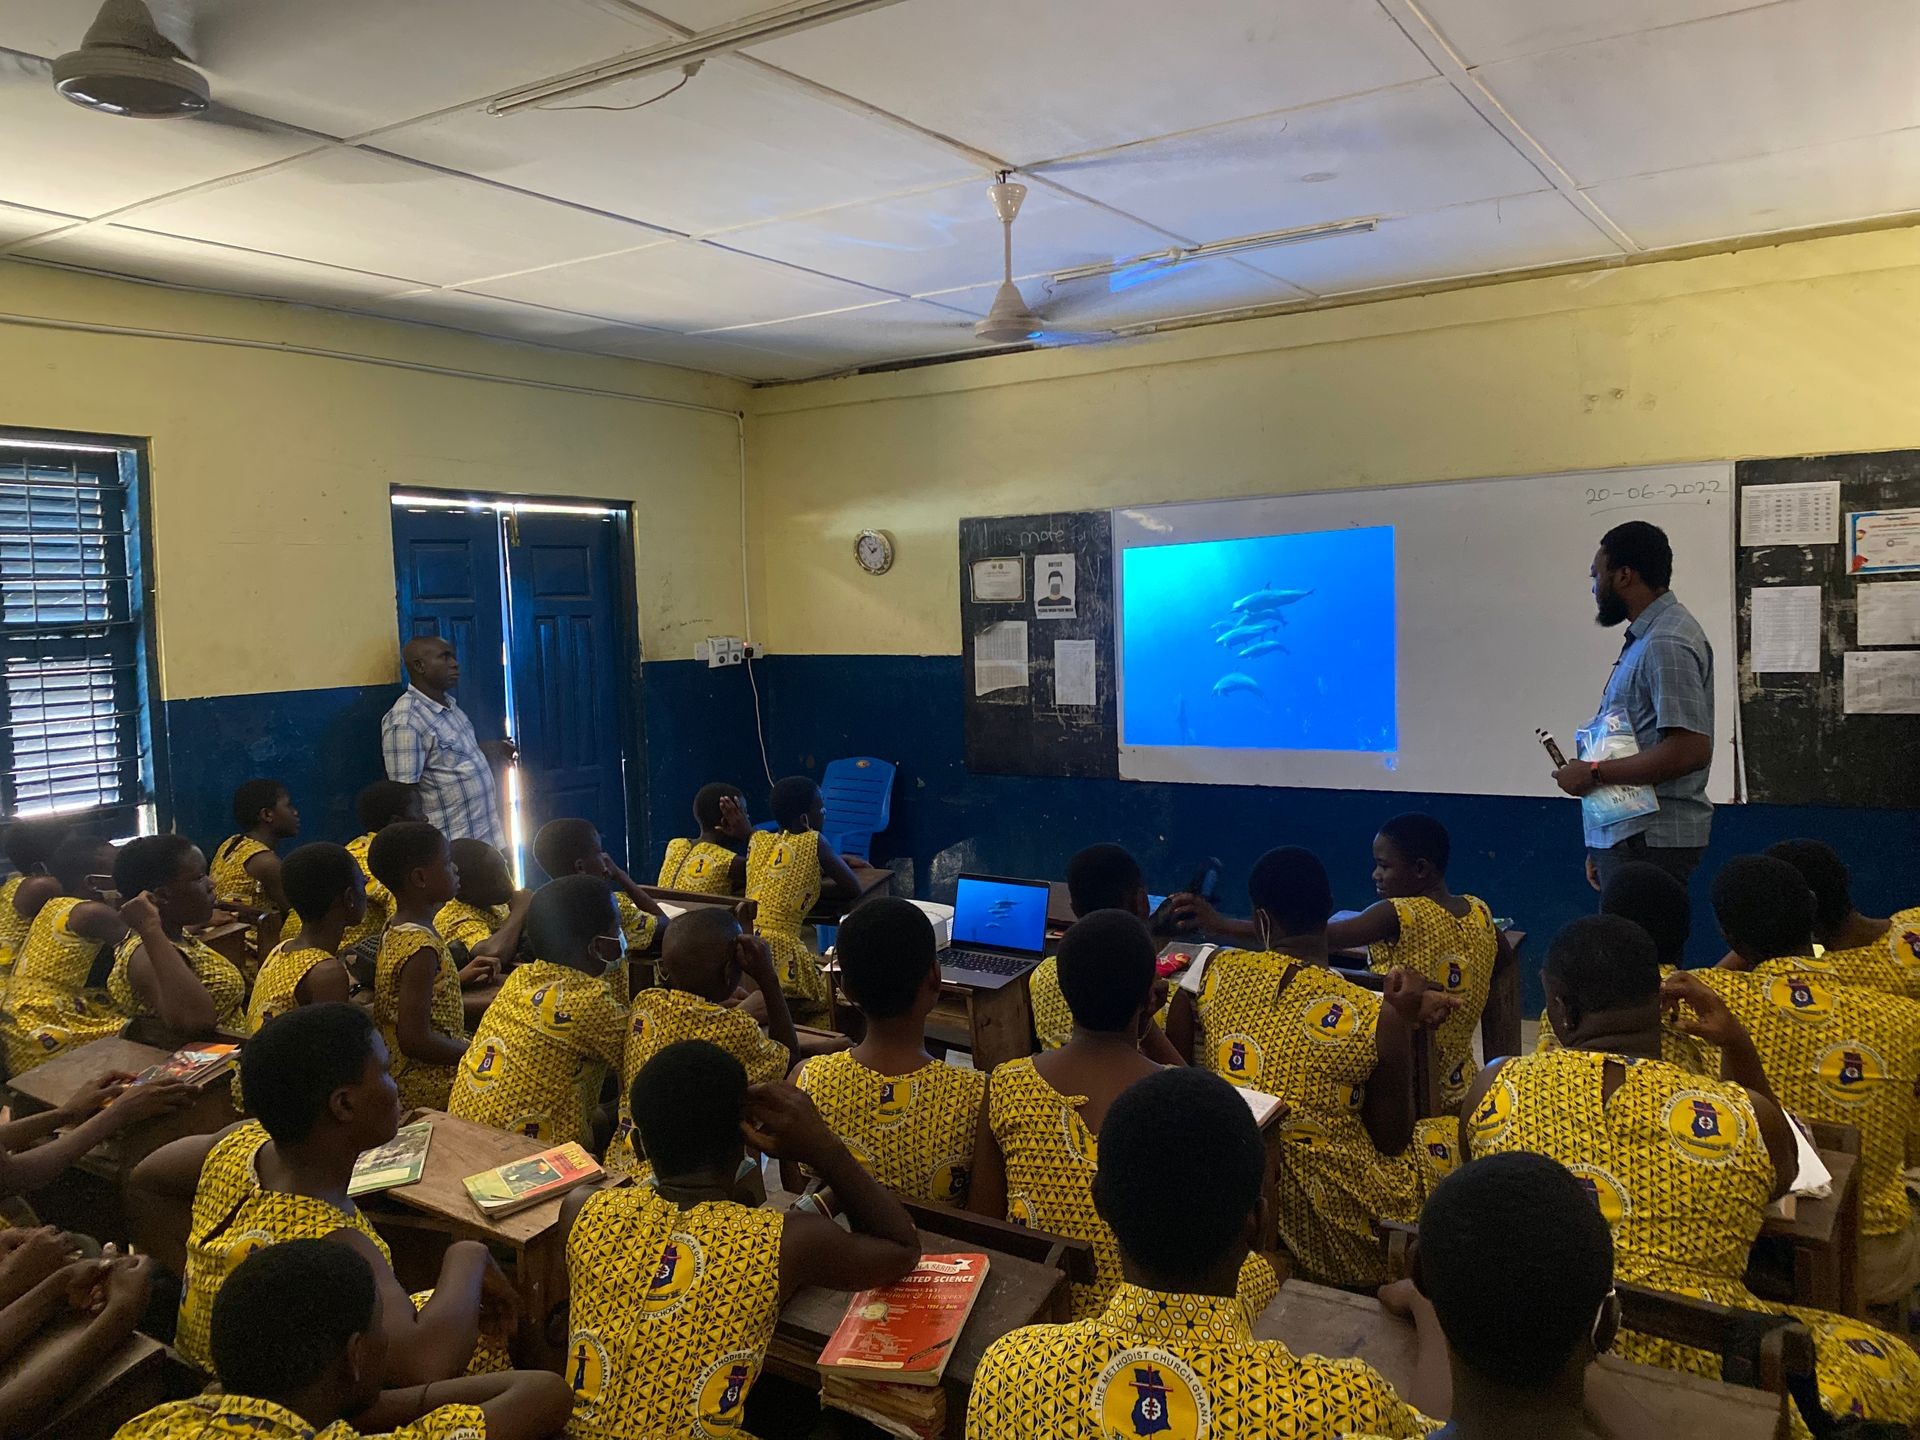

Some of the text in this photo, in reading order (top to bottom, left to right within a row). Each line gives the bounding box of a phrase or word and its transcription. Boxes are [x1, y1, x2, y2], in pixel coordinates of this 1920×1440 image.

[1585, 480, 1728, 504] 20-06-2022
[930, 1263, 957, 1273] SERIES
[933, 1275, 975, 1283] SCIENCE
[693, 1352, 746, 1395] THE METHODIST
[1094, 1351, 1209, 1426] THE METHODIST CHURCH GHANA
